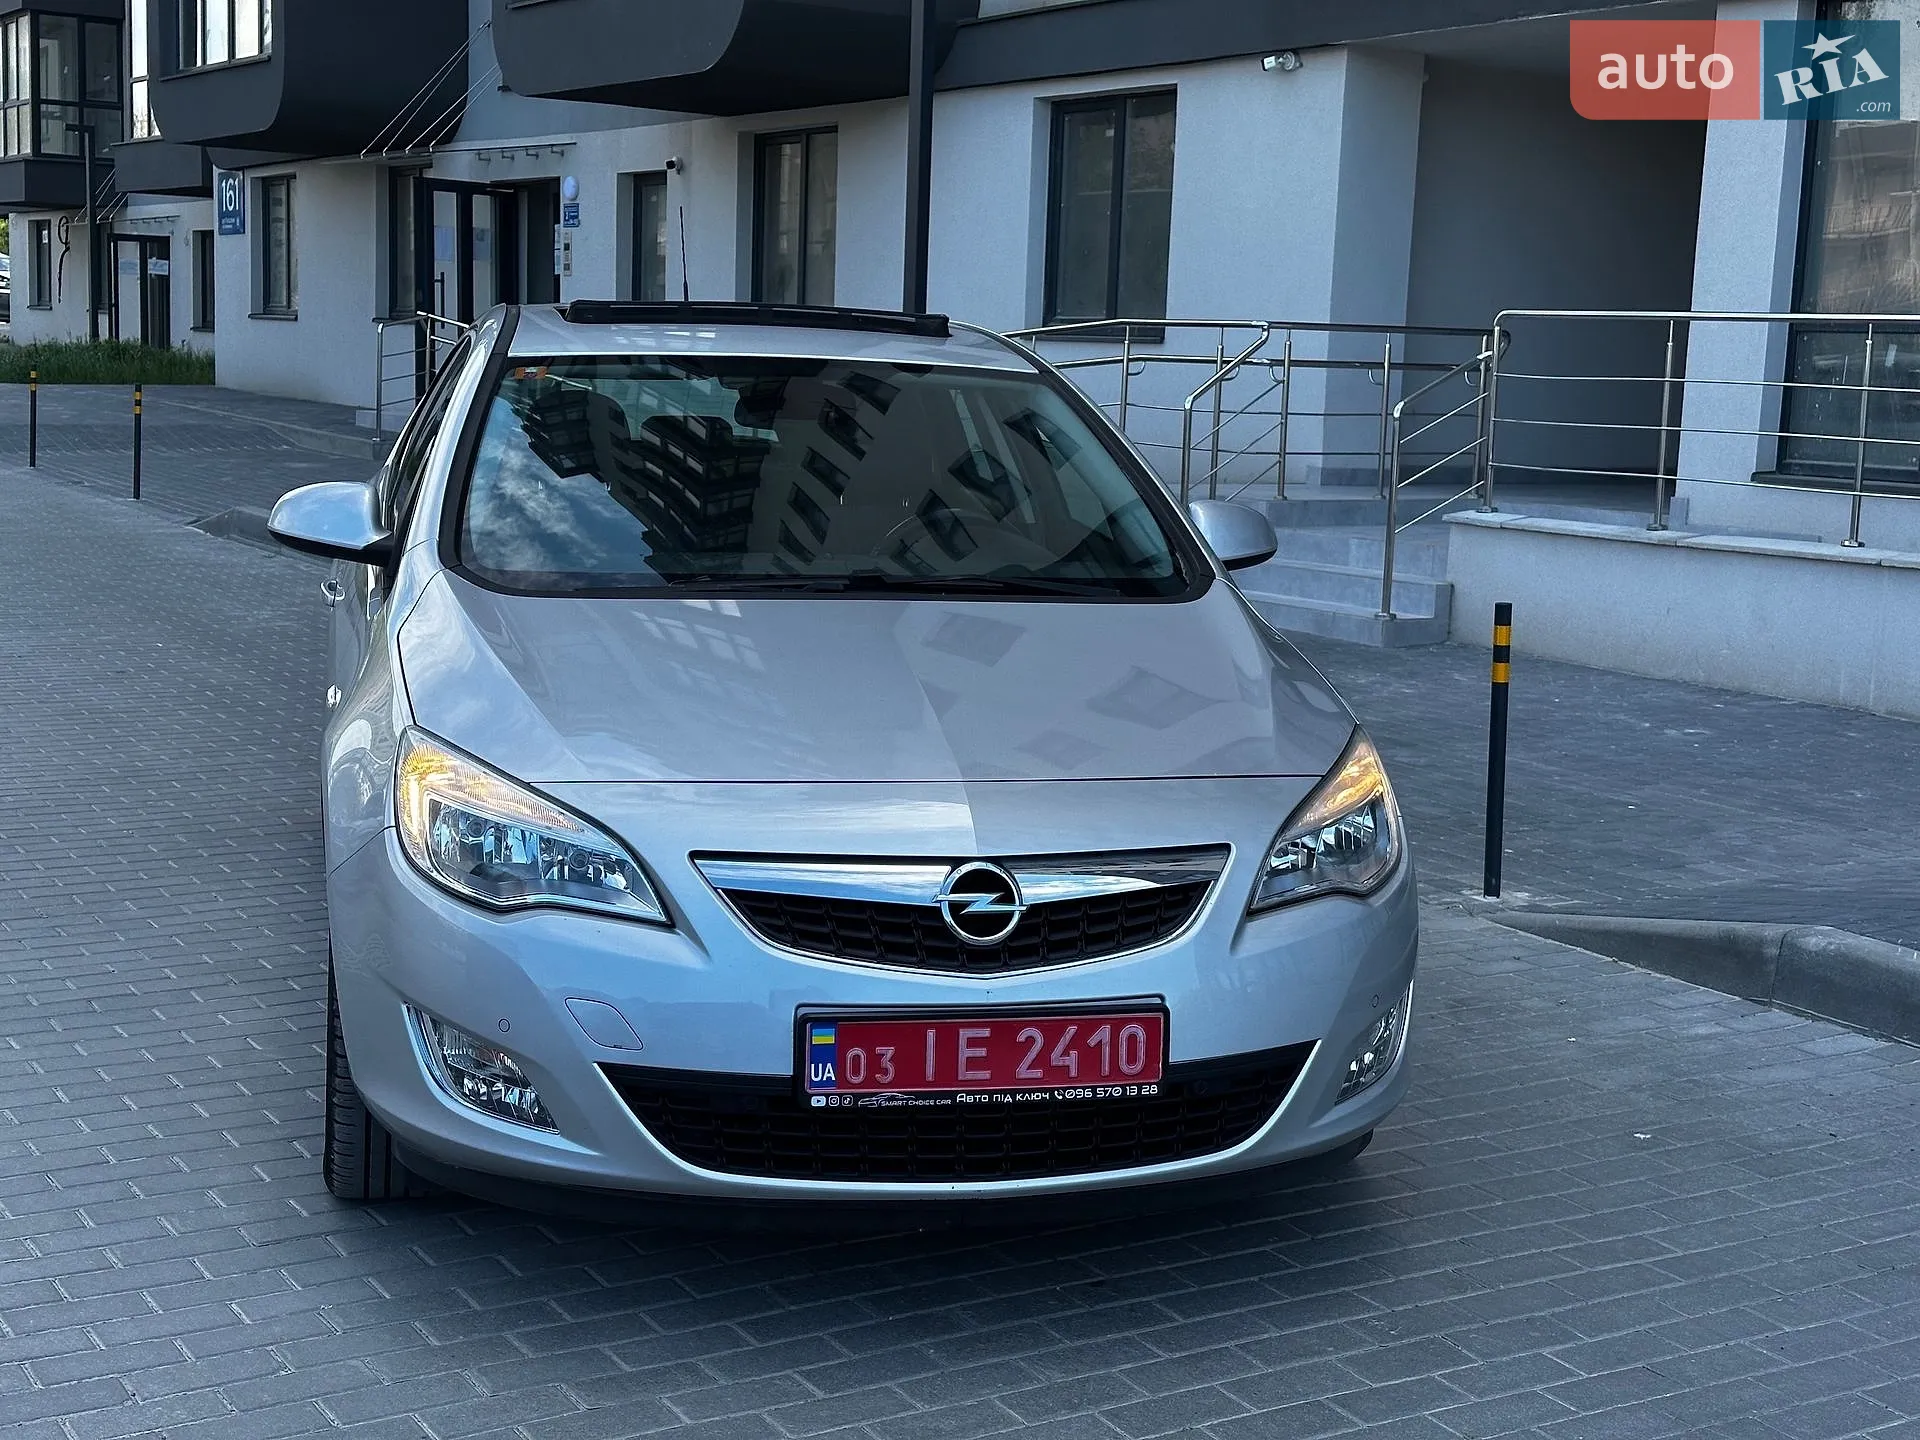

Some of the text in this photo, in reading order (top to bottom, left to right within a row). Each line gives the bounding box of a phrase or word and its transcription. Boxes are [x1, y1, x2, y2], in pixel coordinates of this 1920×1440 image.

[221, 177, 239, 212] 161
[845, 1024, 1147, 1085] 03 IE 2410
[810, 1062, 836, 1082] UA
[1064, 1088, 1093, 1099] 096
[1096, 1086, 1123, 1097] 570
[1125, 1085, 1138, 1096] 13
[1141, 1084, 1158, 1095] 28
